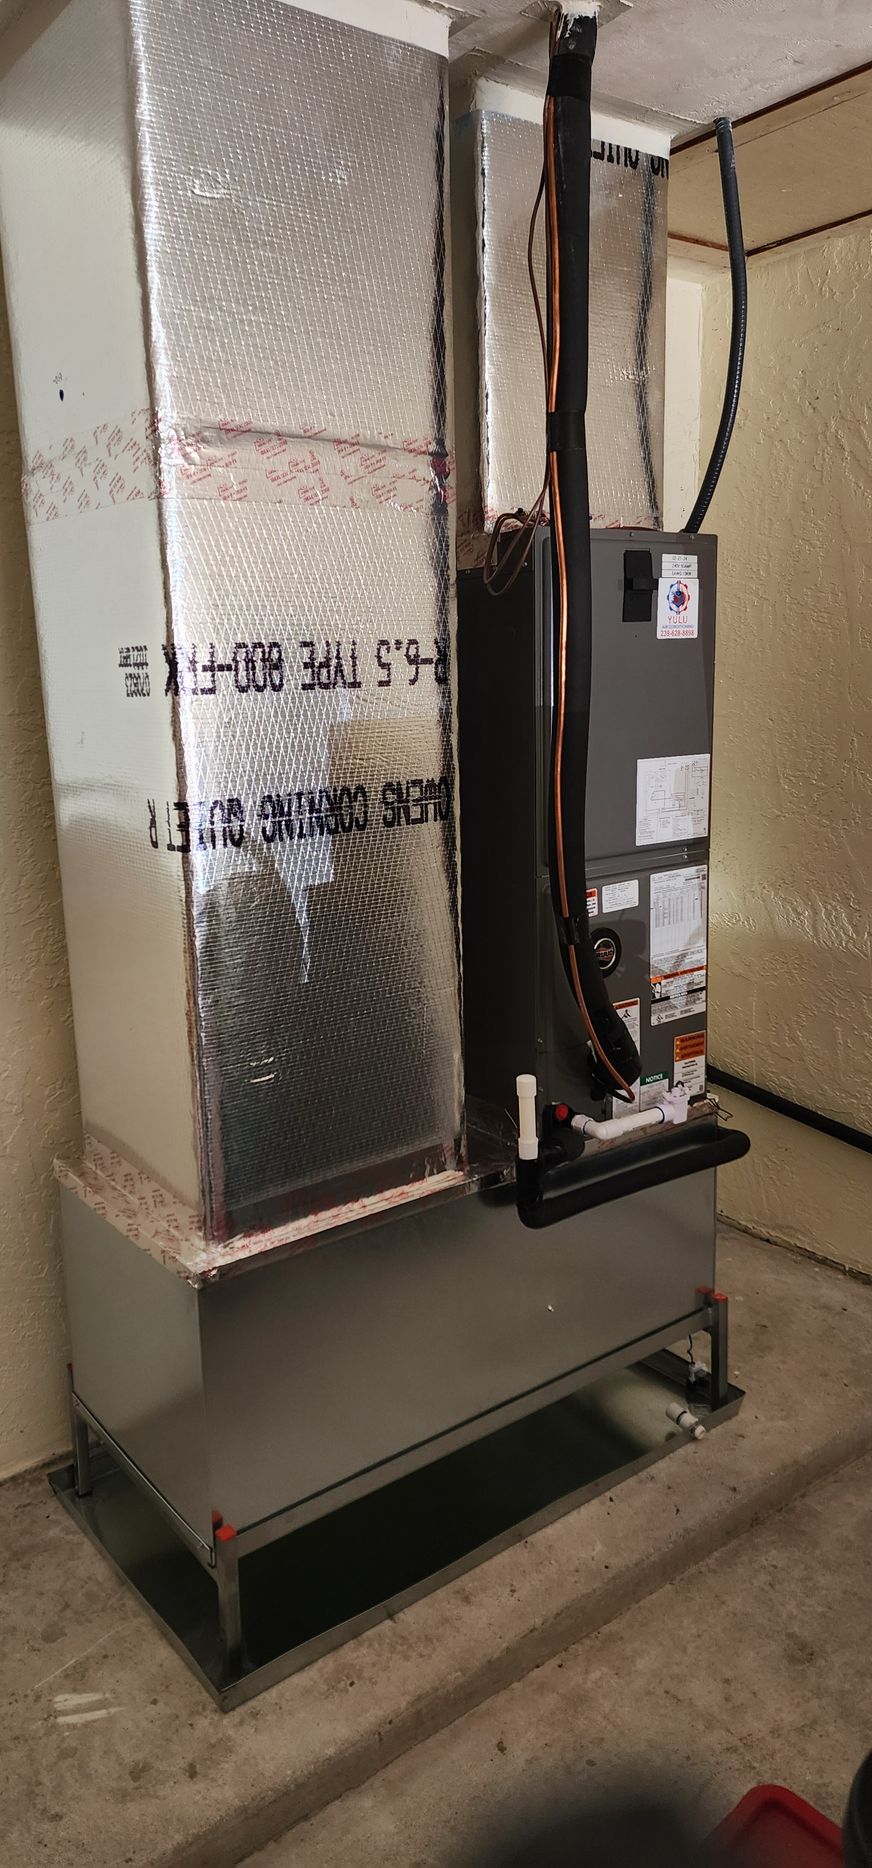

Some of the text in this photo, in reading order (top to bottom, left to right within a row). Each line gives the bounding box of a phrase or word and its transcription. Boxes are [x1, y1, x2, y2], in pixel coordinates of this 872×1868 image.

[667, 616, 688, 624] YULU
[299, 640, 362, 691] TYPE
[375, 638, 449, 688] R-6.5
[261, 784, 369, 845] CORNING
[381, 776, 451, 829] OWENS
[645, 1072, 664, 1084] NOTICE
